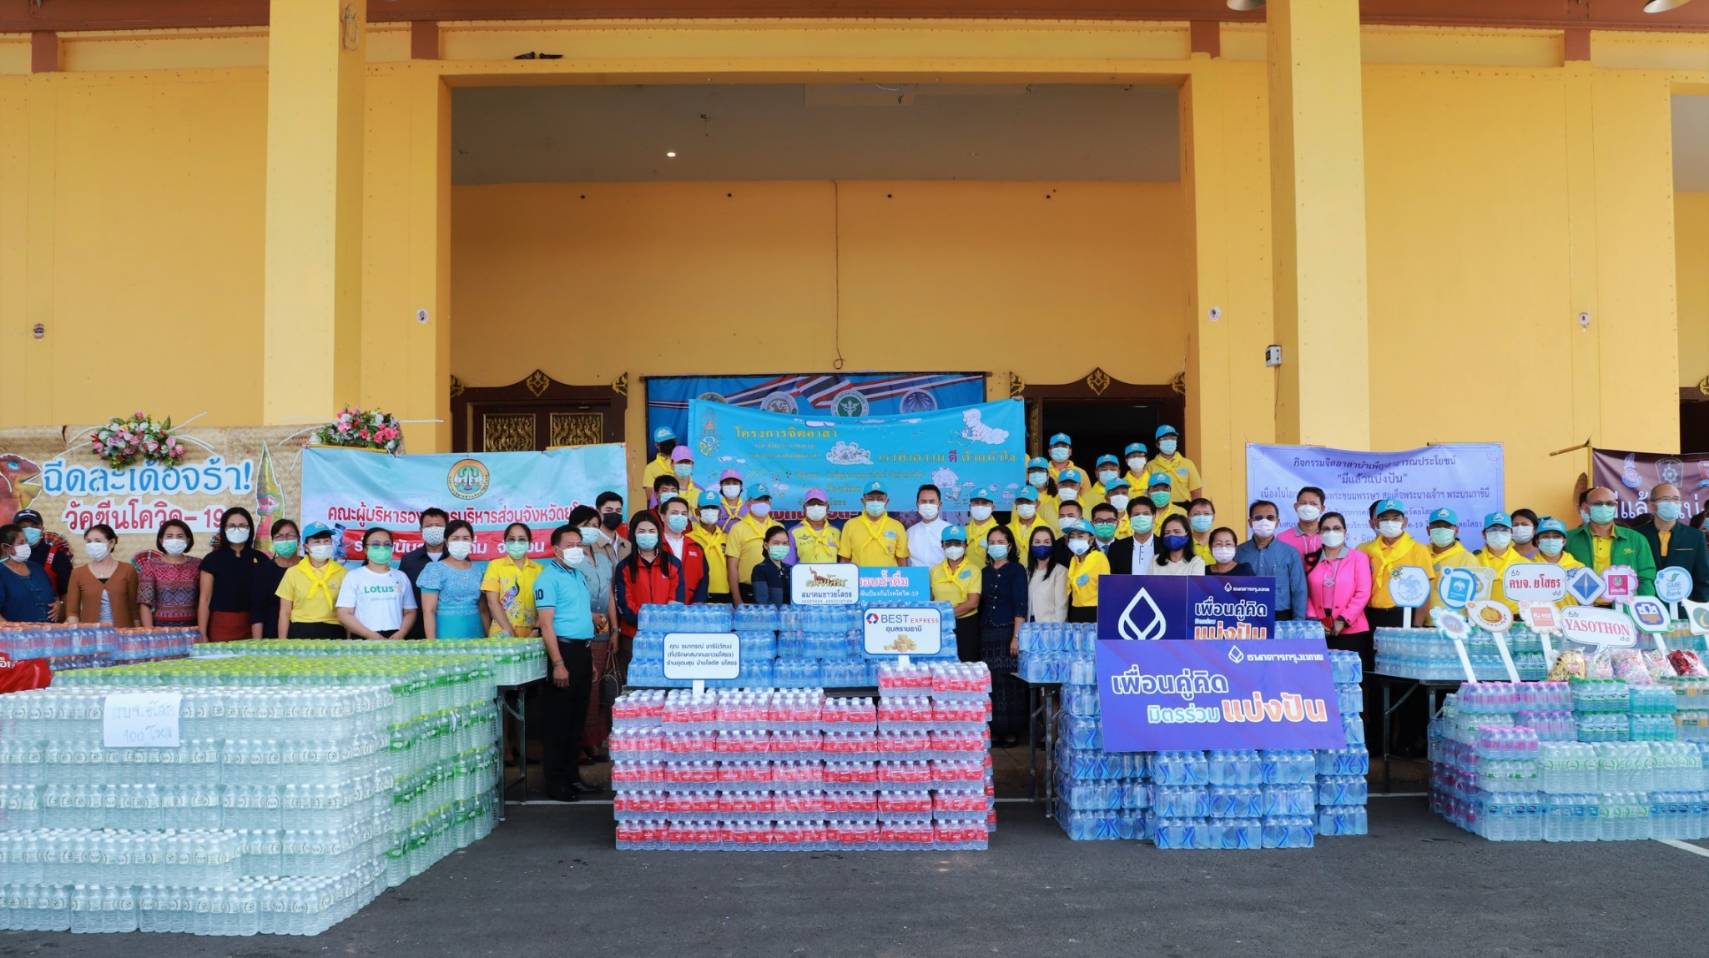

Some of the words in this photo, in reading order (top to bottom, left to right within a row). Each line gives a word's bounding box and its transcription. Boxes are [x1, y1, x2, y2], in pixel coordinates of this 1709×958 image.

[948, 449, 957, 463] ดี
[1534, 573, 1561, 588] ยโสธร
[364, 585, 394, 594] Lotus
[1194, 595, 1268, 621] เพื่อนคู่คิด
[881, 614, 909, 624] BEST
[1564, 618, 1630, 636] YASOTHON
[1111, 664, 1229, 701] เพื่อนคู่คิด
[1147, 704, 1220, 724] มิตรร่วม
[1221, 691, 1328, 723] แบ่งปัน
